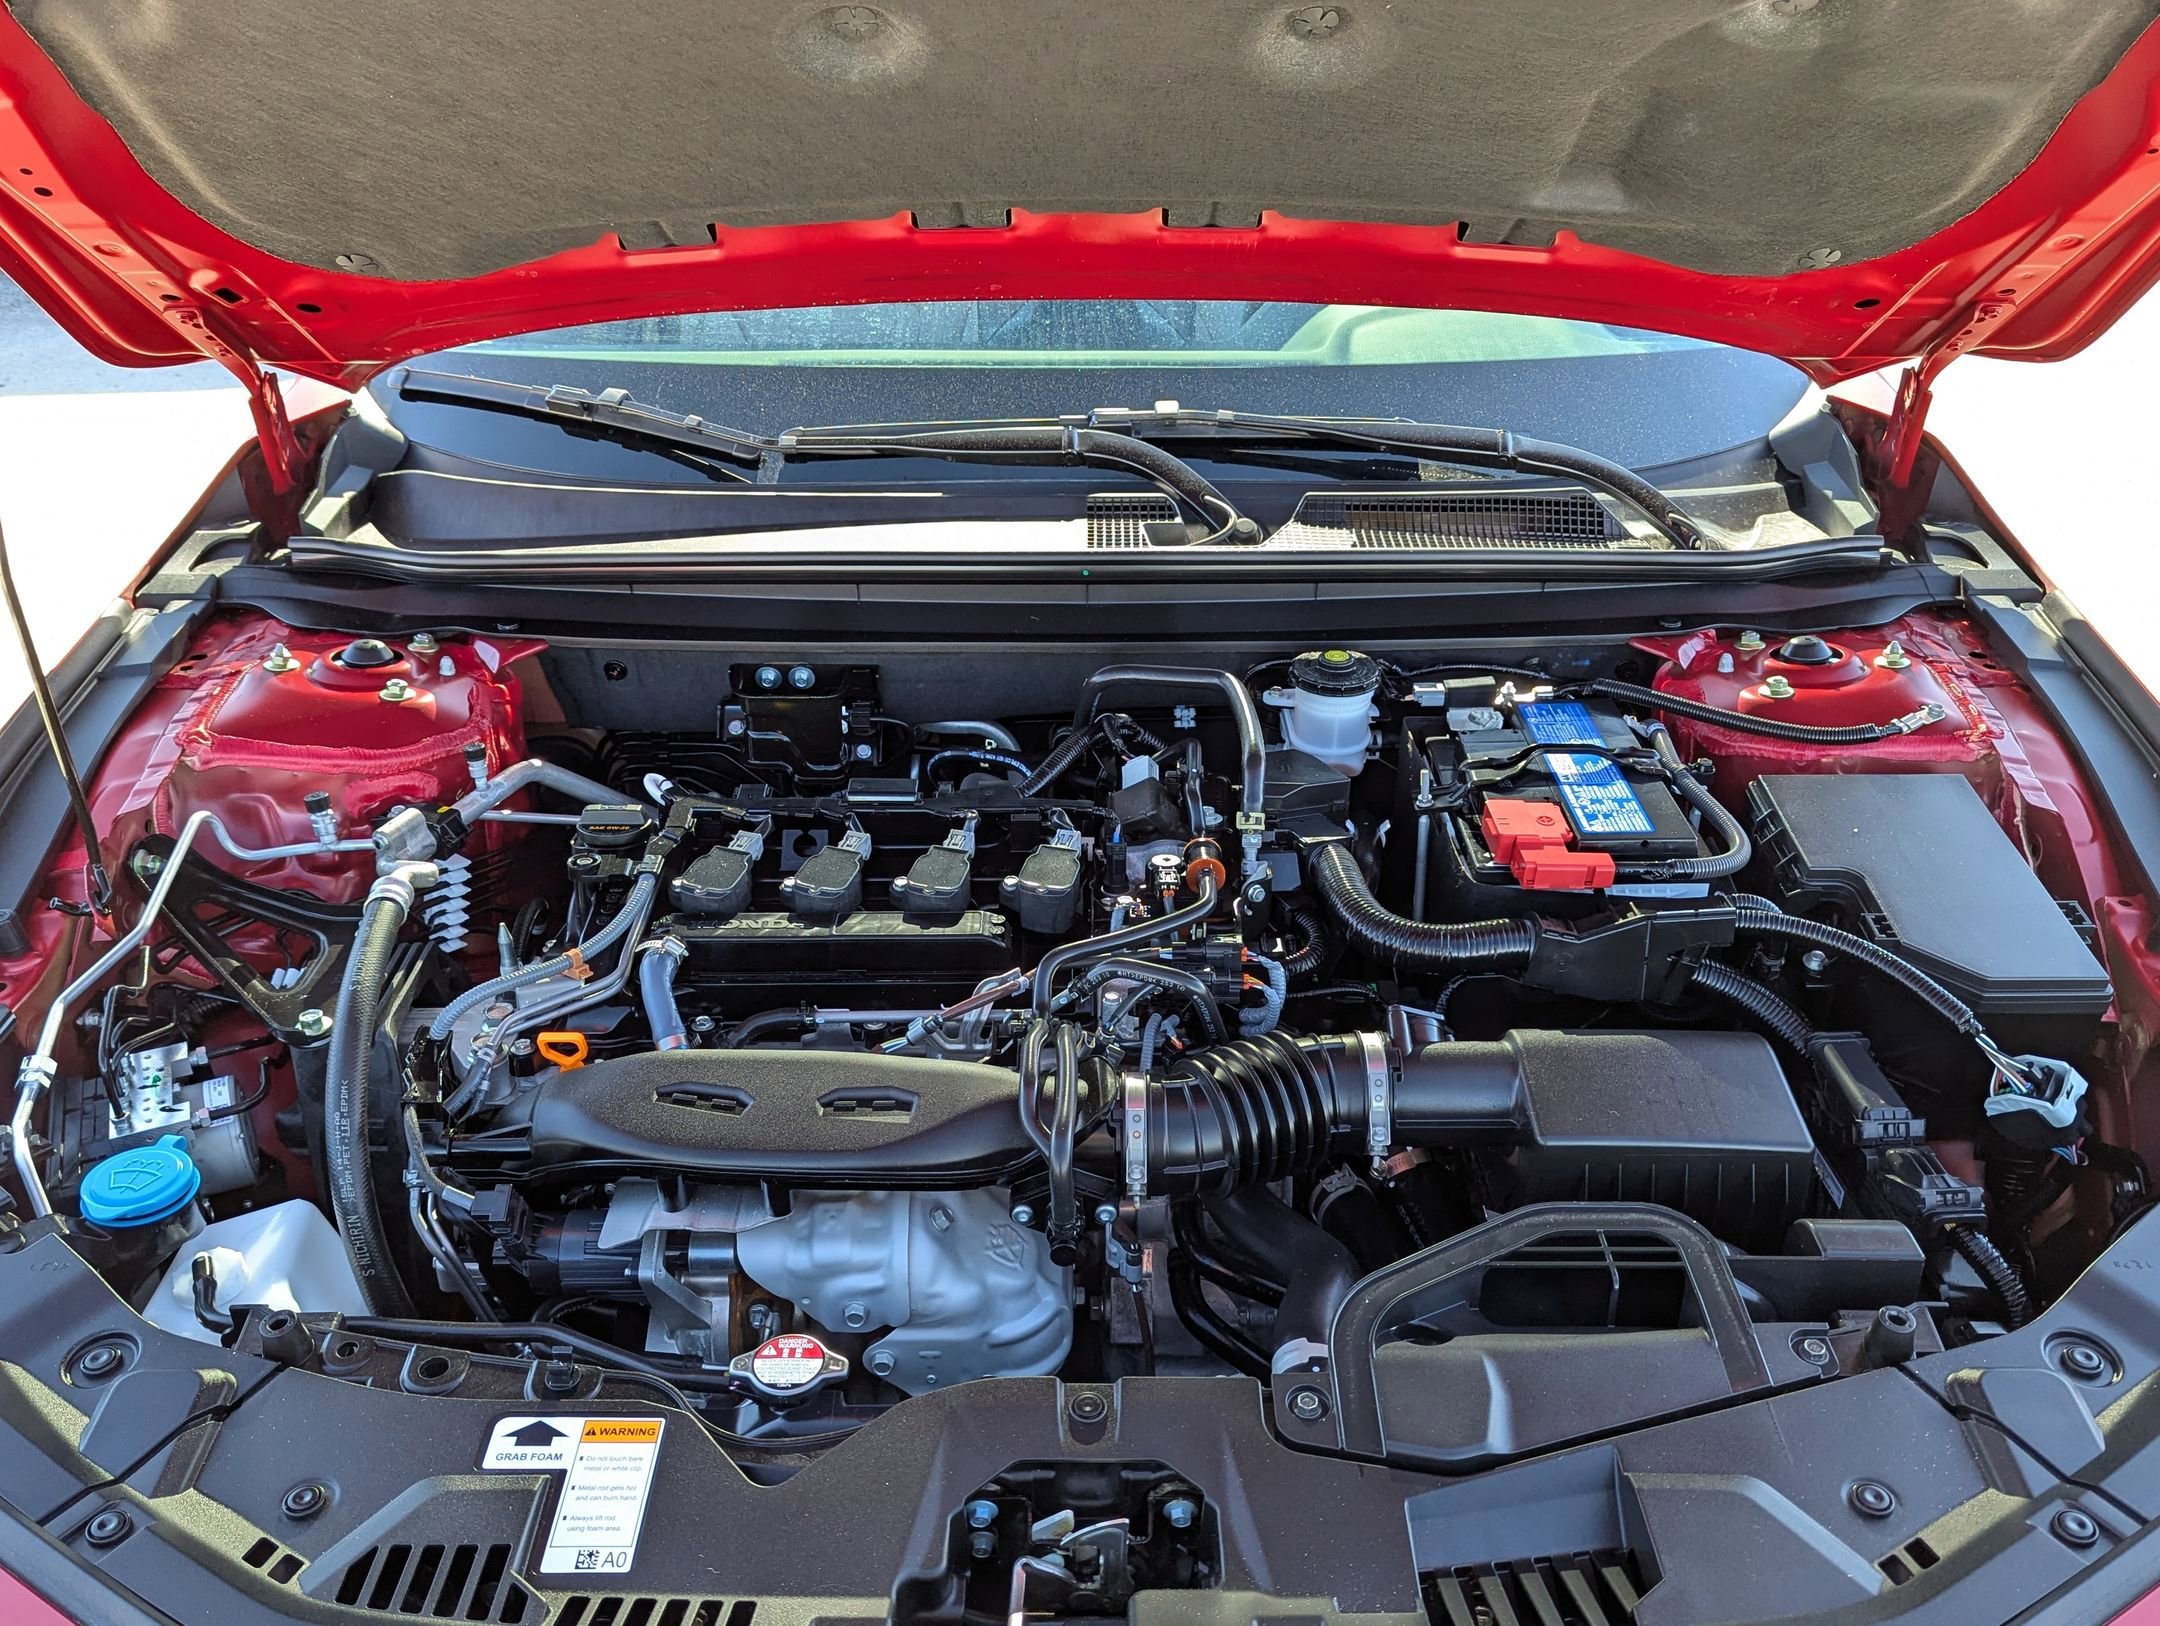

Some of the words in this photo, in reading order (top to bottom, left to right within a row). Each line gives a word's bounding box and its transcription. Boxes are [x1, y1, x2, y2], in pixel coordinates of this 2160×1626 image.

[687, 919, 804, 930] HONDA
[599, 1427, 656, 1436] WARNING
[495, 1453, 527, 1461] GRAB
[530, 1453, 563, 1461] FOAM
[601, 1551, 628, 1568] A0
